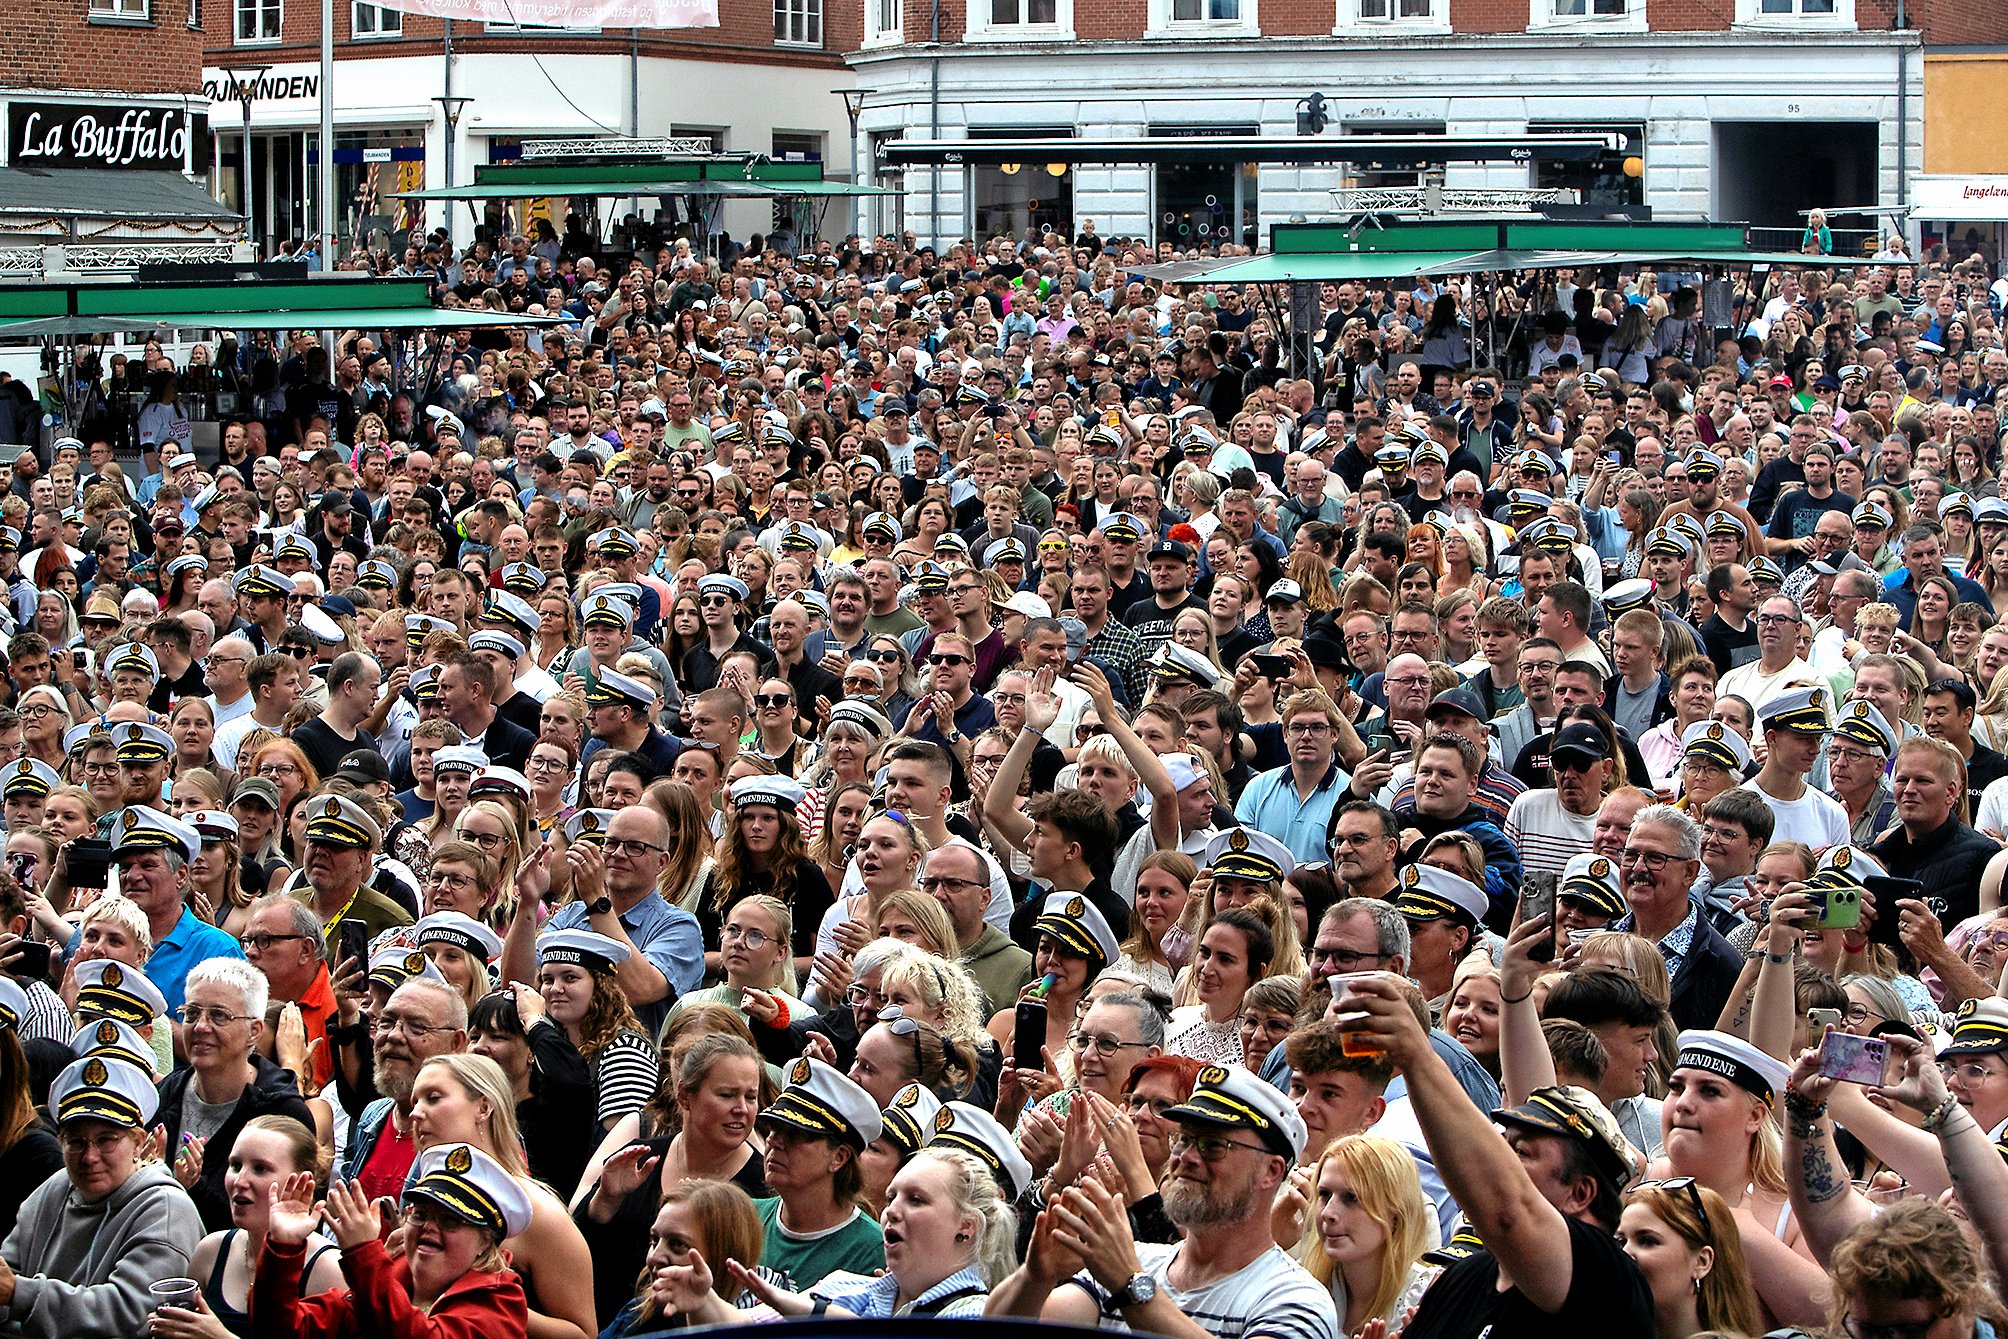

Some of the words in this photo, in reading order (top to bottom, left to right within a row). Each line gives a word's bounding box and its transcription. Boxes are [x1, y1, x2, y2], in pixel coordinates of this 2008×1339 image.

[1787, 104, 1800, 113] 95
[19, 111, 63, 158] La
[71, 109, 186, 165] Buffalo
[1962, 185, 2008, 199] Langelæn
